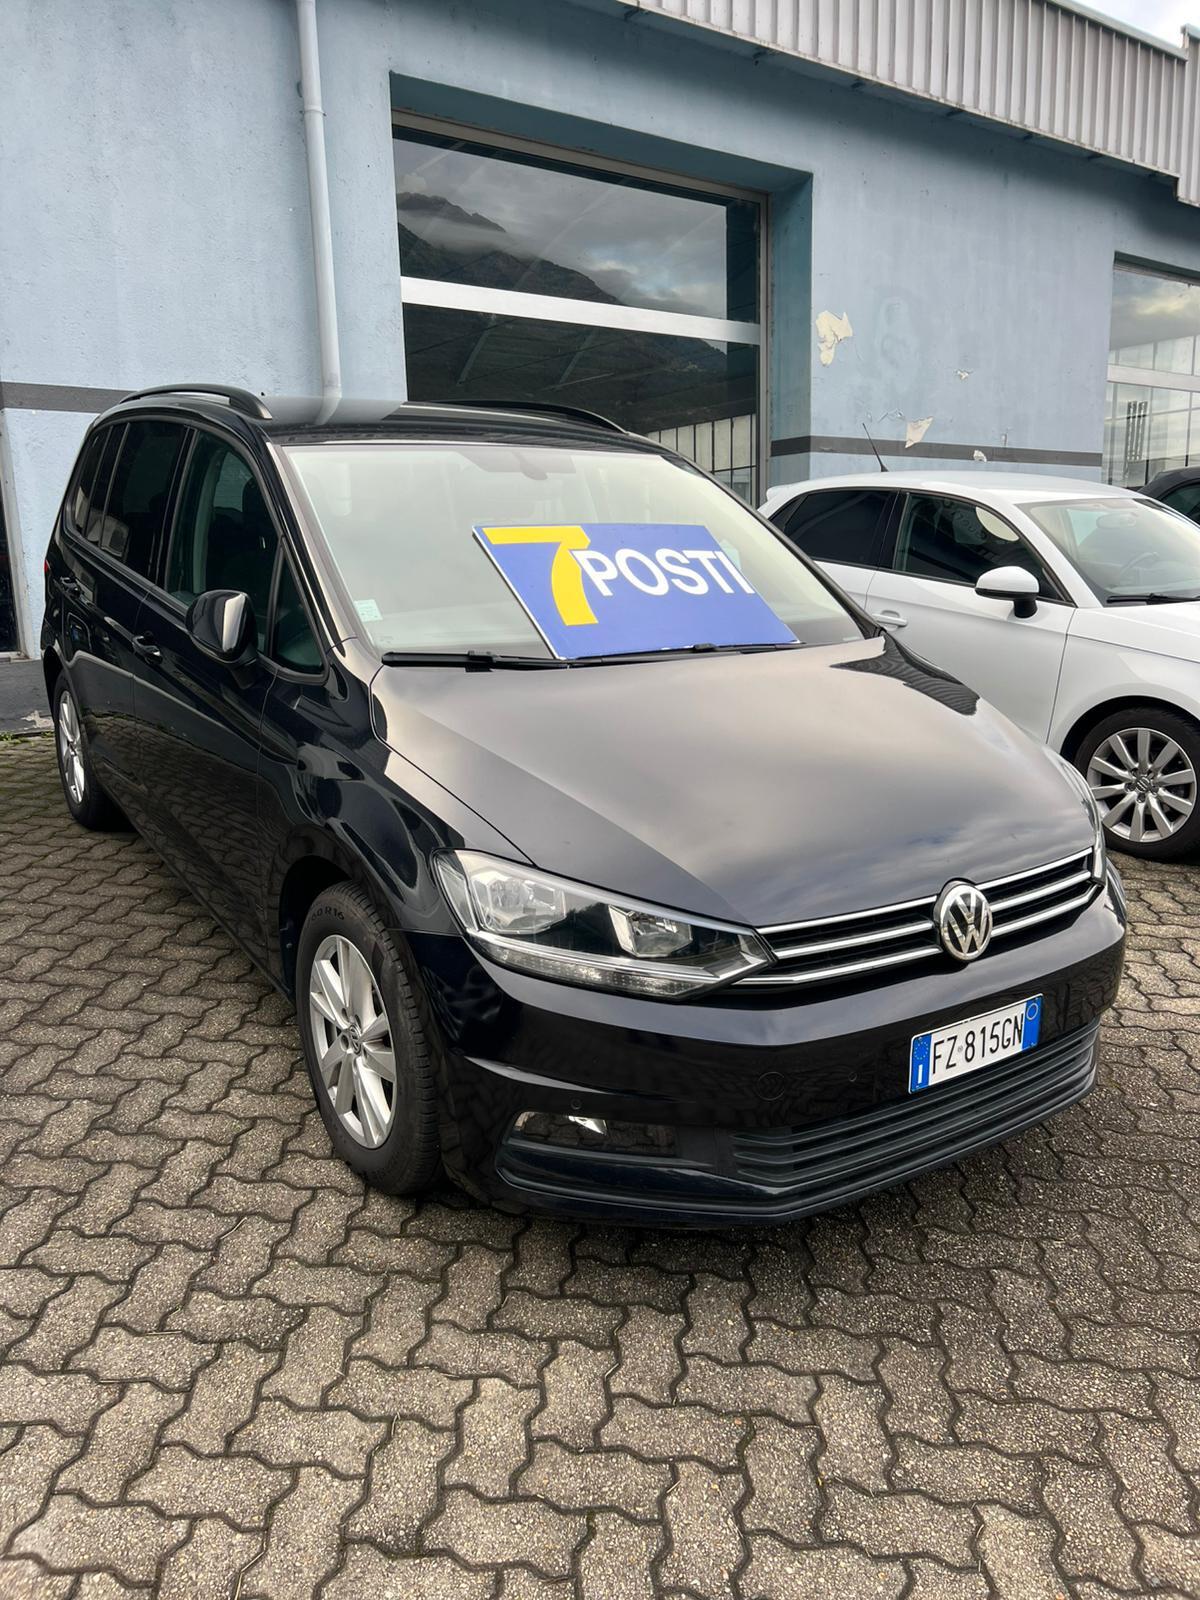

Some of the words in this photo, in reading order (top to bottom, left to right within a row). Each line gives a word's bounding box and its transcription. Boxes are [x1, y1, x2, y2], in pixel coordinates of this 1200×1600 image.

[482, 525, 598, 626] 7
[569, 548, 756, 597] POSTI
[943, 889, 989, 957] VW
[965, 1012, 1024, 1063] 815GN
